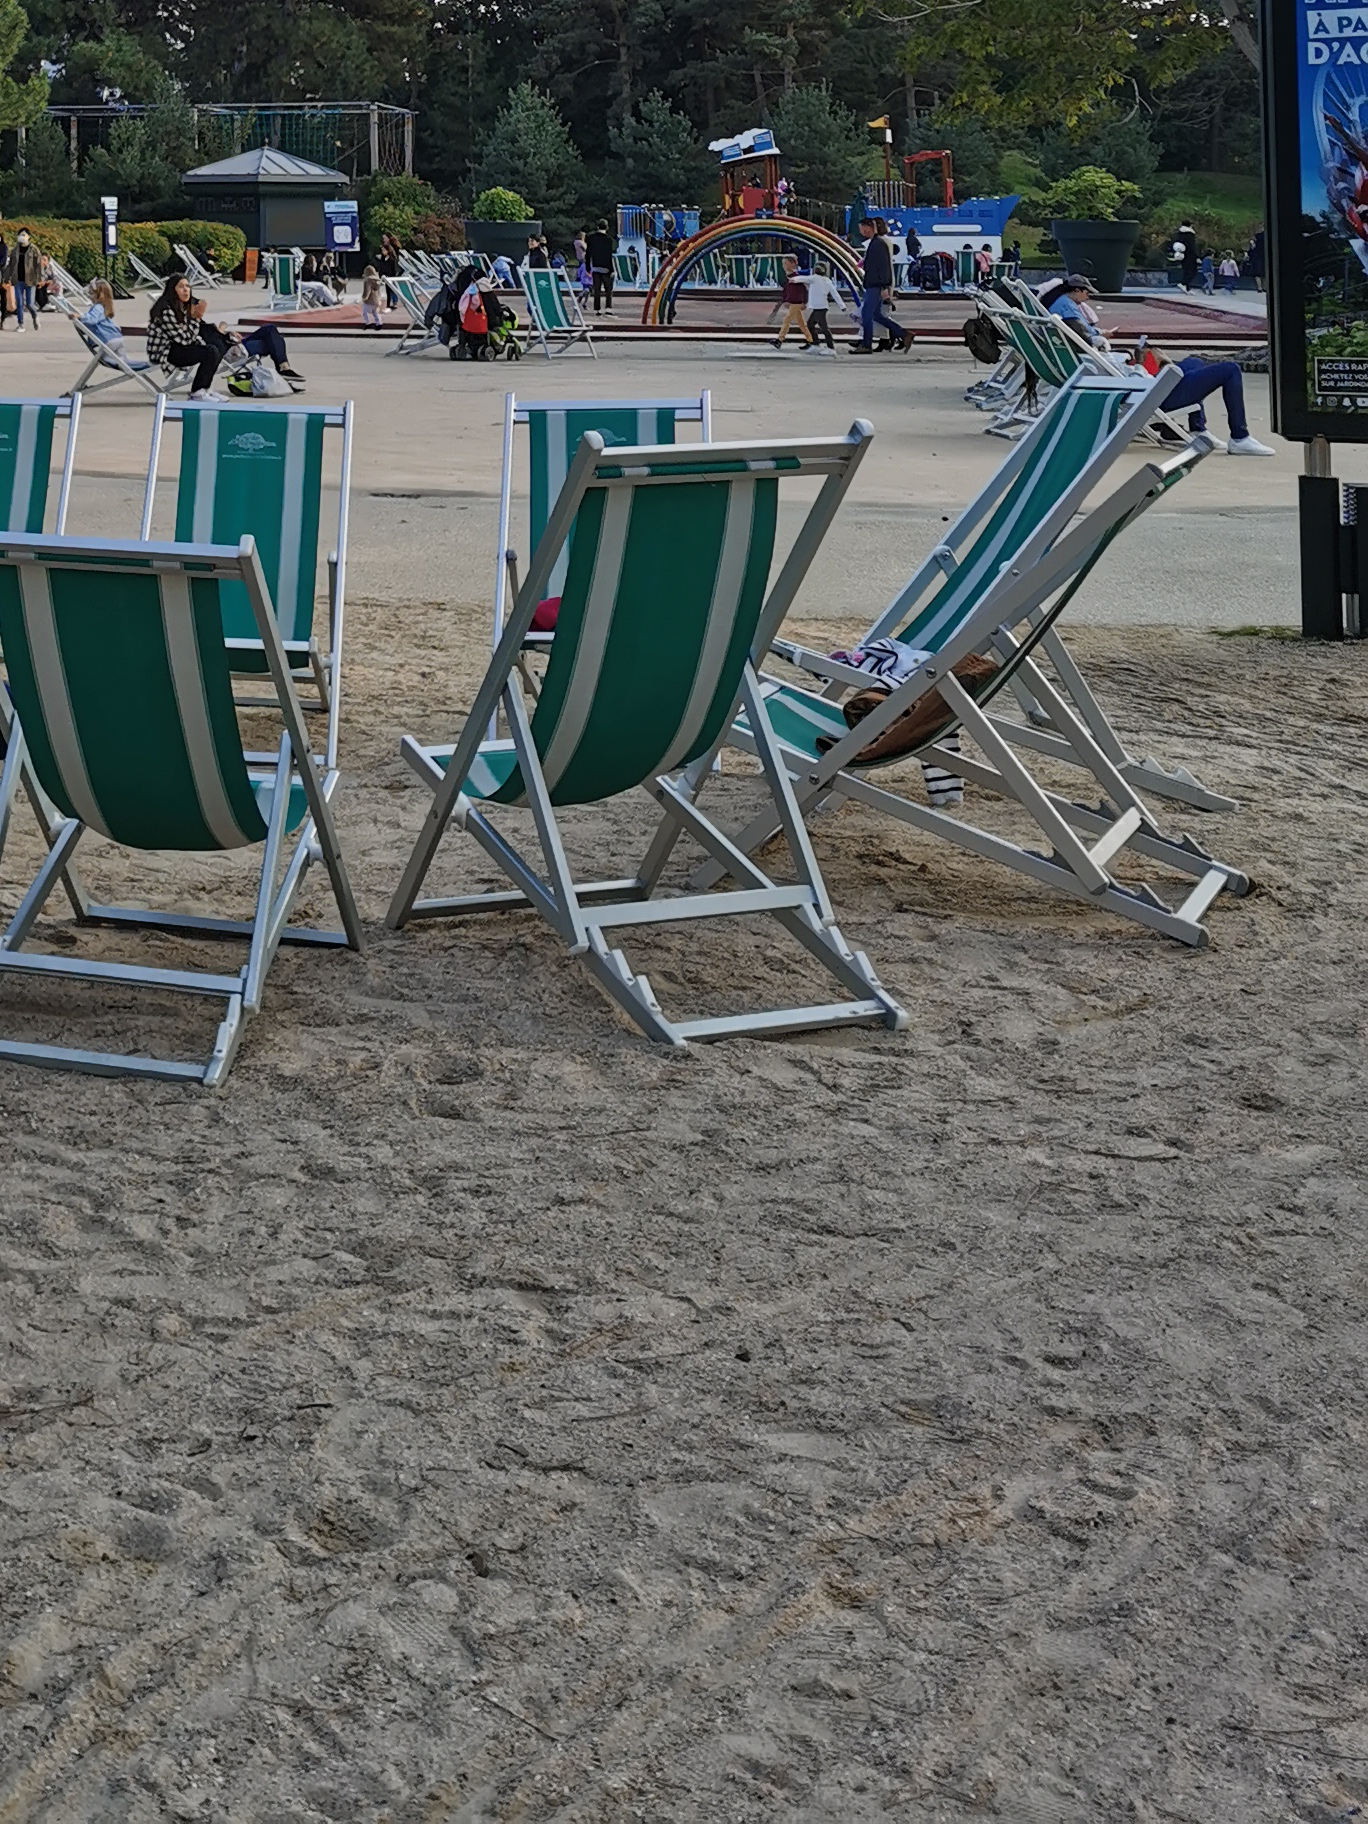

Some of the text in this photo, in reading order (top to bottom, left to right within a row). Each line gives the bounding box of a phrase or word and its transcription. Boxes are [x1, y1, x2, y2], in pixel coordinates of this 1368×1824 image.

[1313, 12, 1368, 35] À PA
[1320, 361, 1350, 370] ACCÈS
